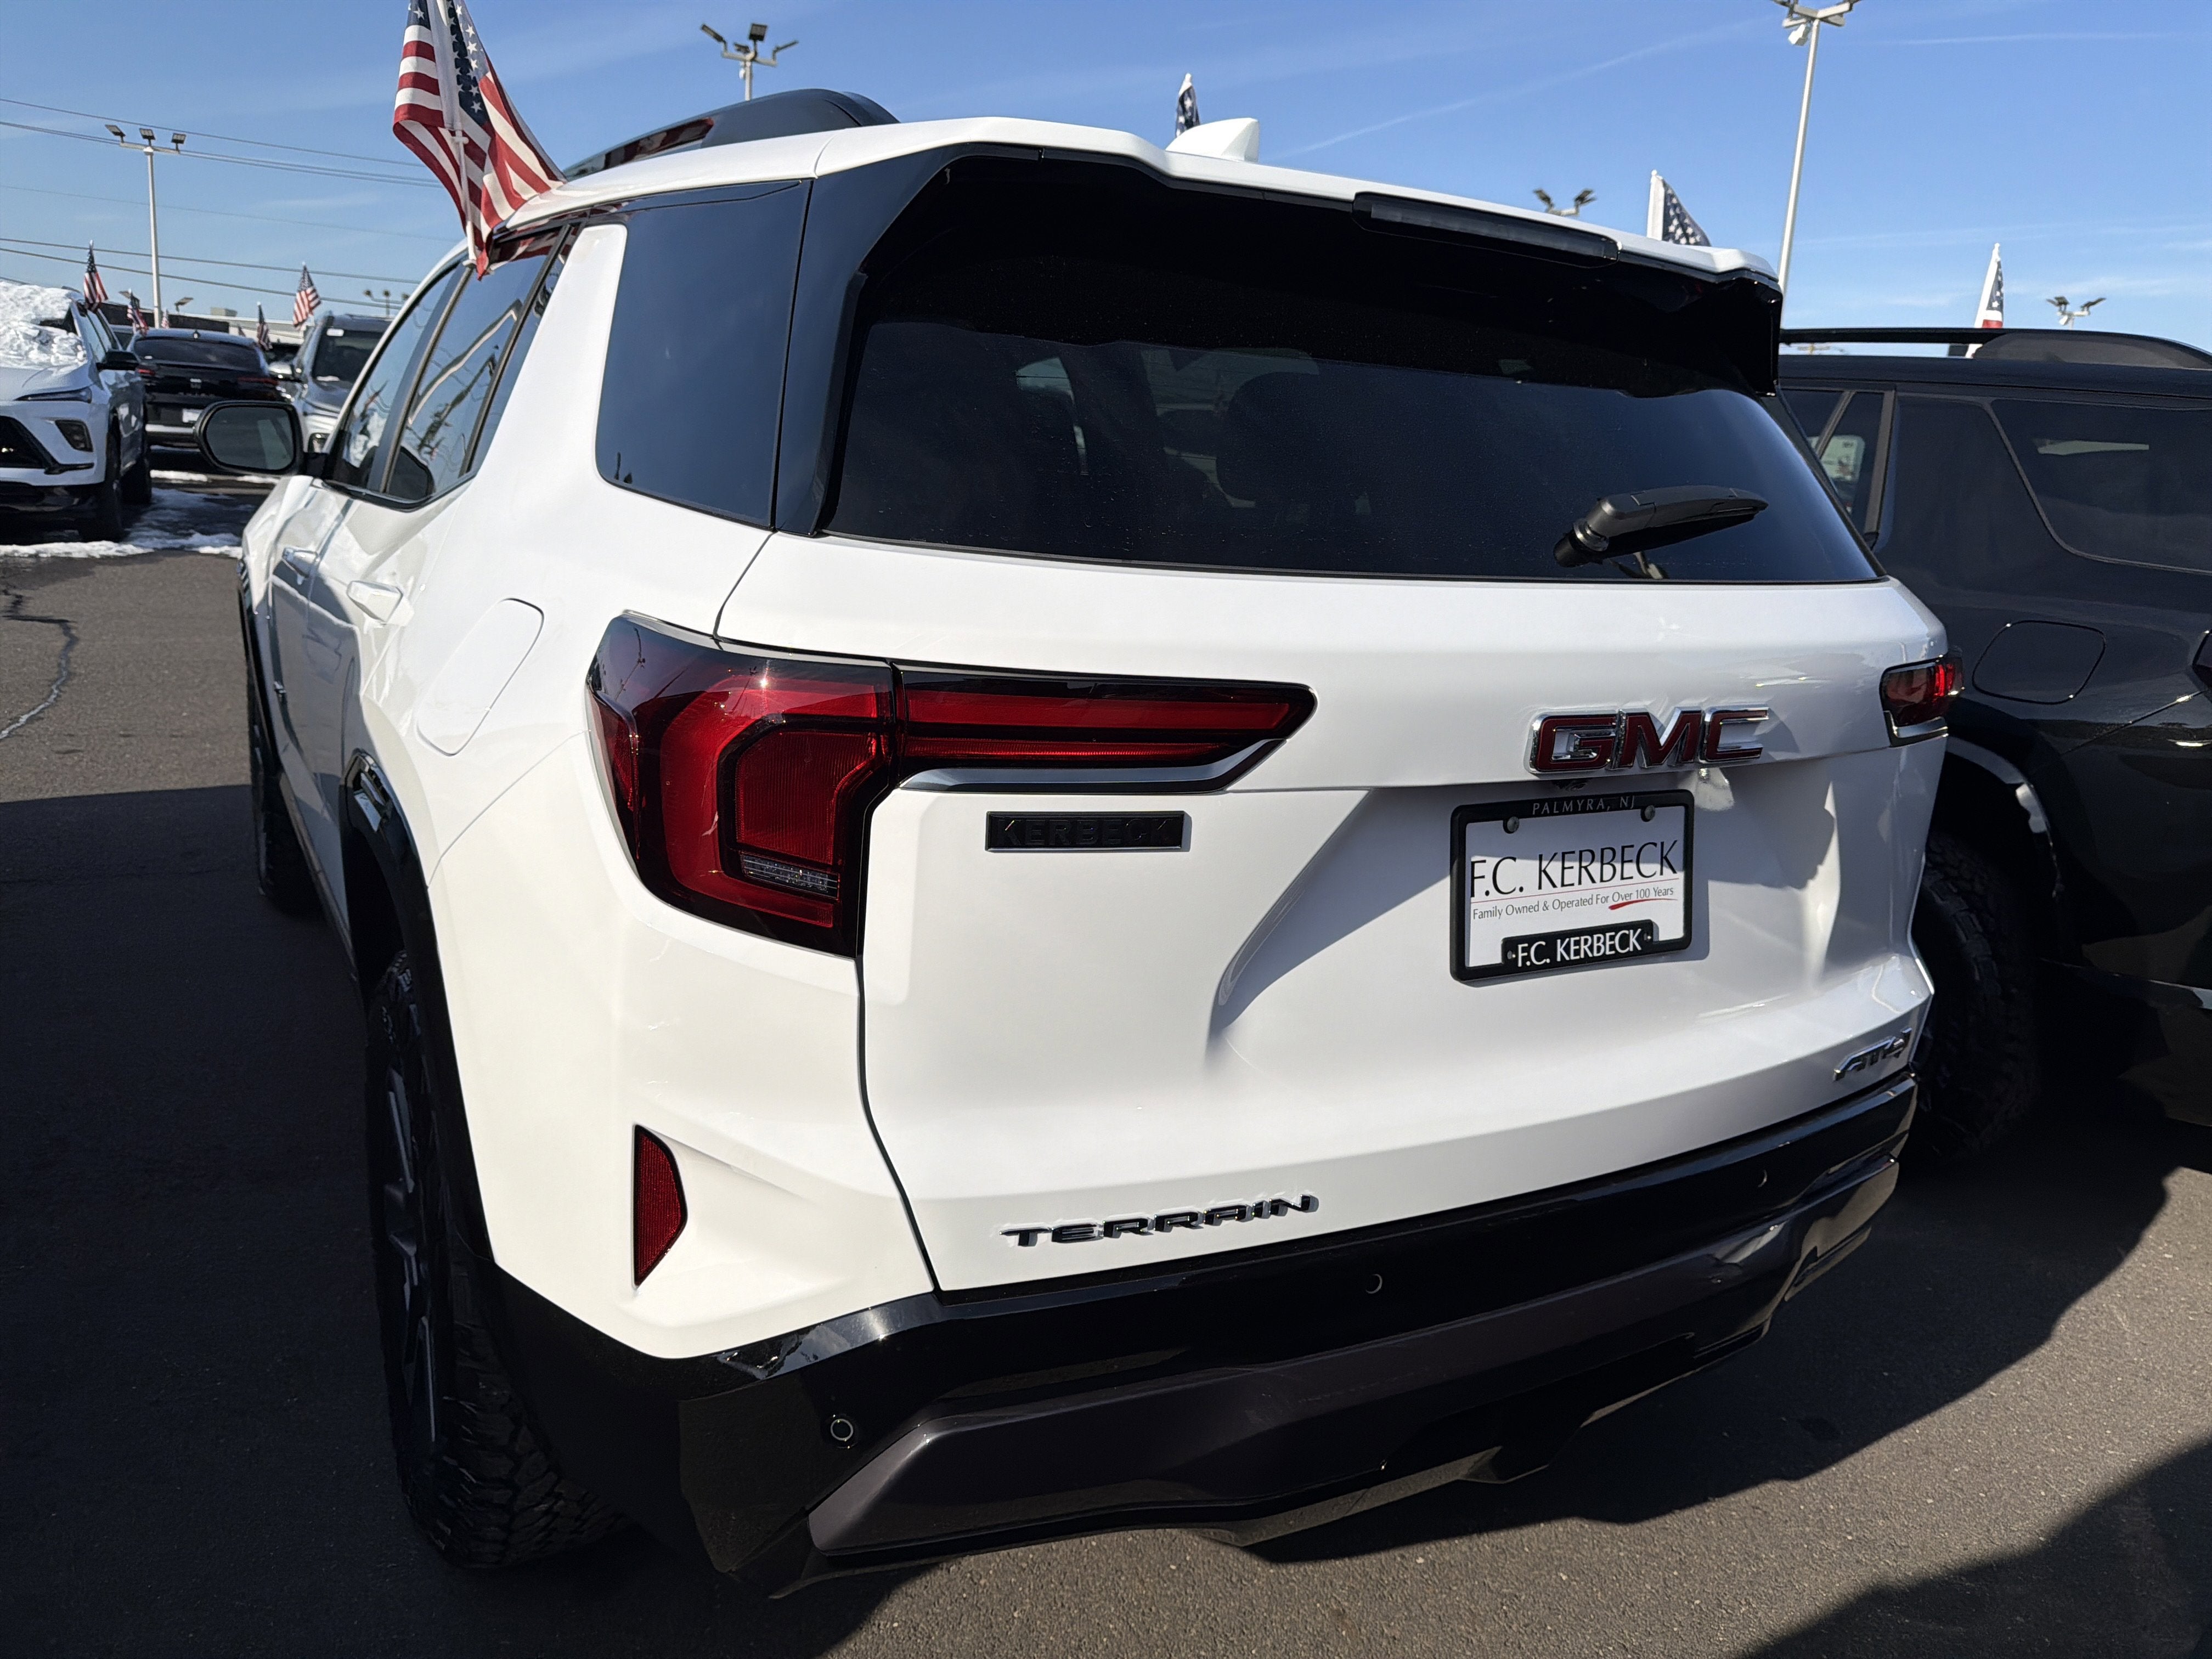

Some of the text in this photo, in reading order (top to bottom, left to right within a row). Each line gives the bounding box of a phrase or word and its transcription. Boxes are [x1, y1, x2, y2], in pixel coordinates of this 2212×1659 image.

[1528, 707, 1769, 772] GMC
[1532, 795, 1635, 815] PALMYRA, NJ
[998, 817, 1174, 847] KERBECK
[1470, 840, 1678, 898] F.C. KERBECK
[1472, 886, 1674, 919] Family Owned & Operated For Over 100 Years
[1517, 928, 1642, 967] F.C. KERBECK
[999, 1193, 1317, 1246] TERRAIN
